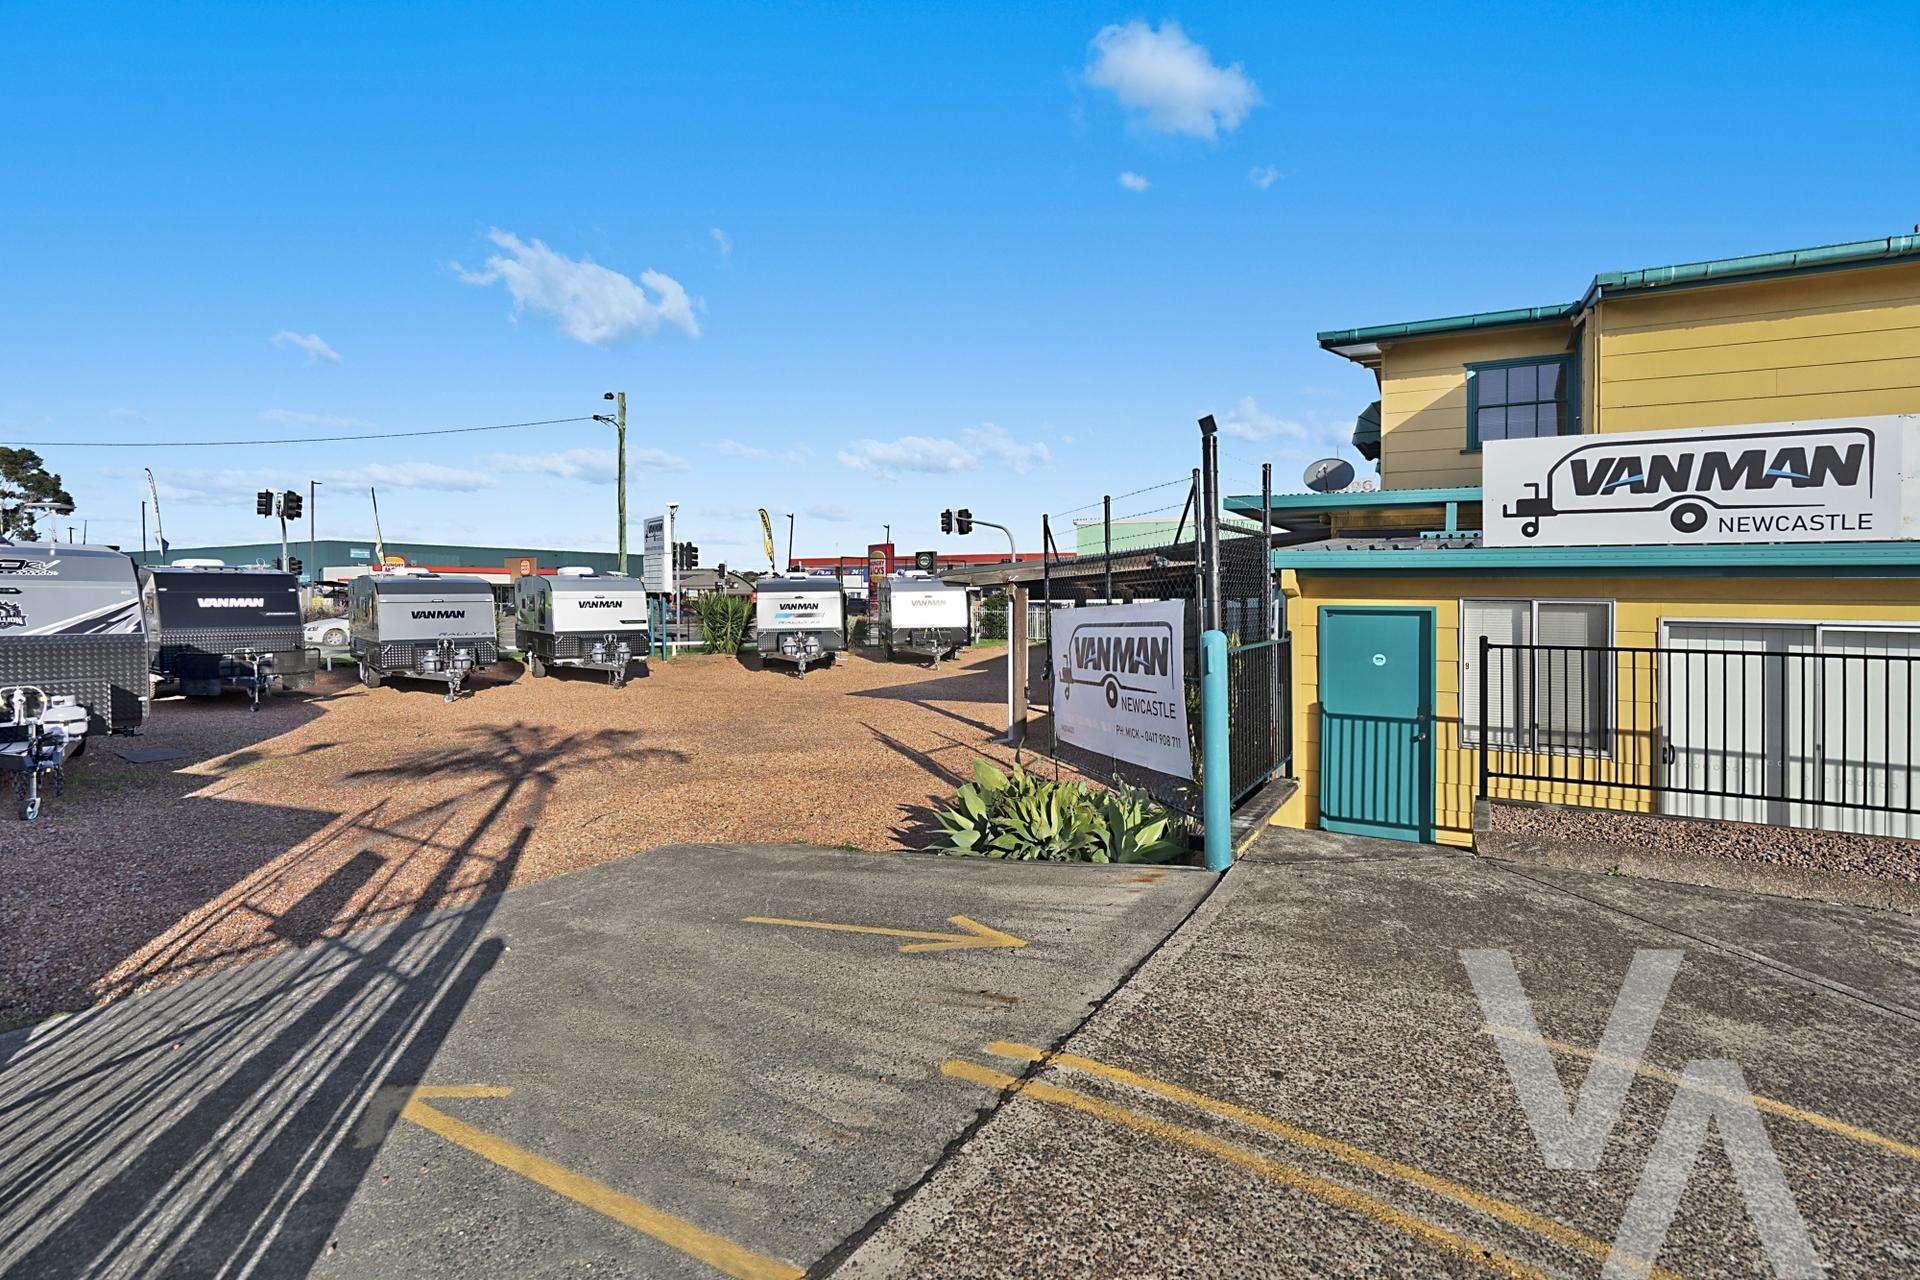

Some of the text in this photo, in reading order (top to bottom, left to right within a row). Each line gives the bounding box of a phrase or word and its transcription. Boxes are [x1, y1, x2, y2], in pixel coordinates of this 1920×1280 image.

[1570, 444, 1865, 496] VANMAN
[1718, 513, 1873, 533] NEWCASTLE
[197, 598, 264, 607] VANMAN
[411, 610, 465, 619] VANMAN
[1074, 636, 1169, 676] VANMAN
[1121, 696, 1176, 720] NEWCASTLE
[1125, 727, 1140, 739] MICK
[1145, 730, 1158, 743] 0417
[1159, 733, 1171, 746] 908
[1172, 736, 1181, 748] 711
